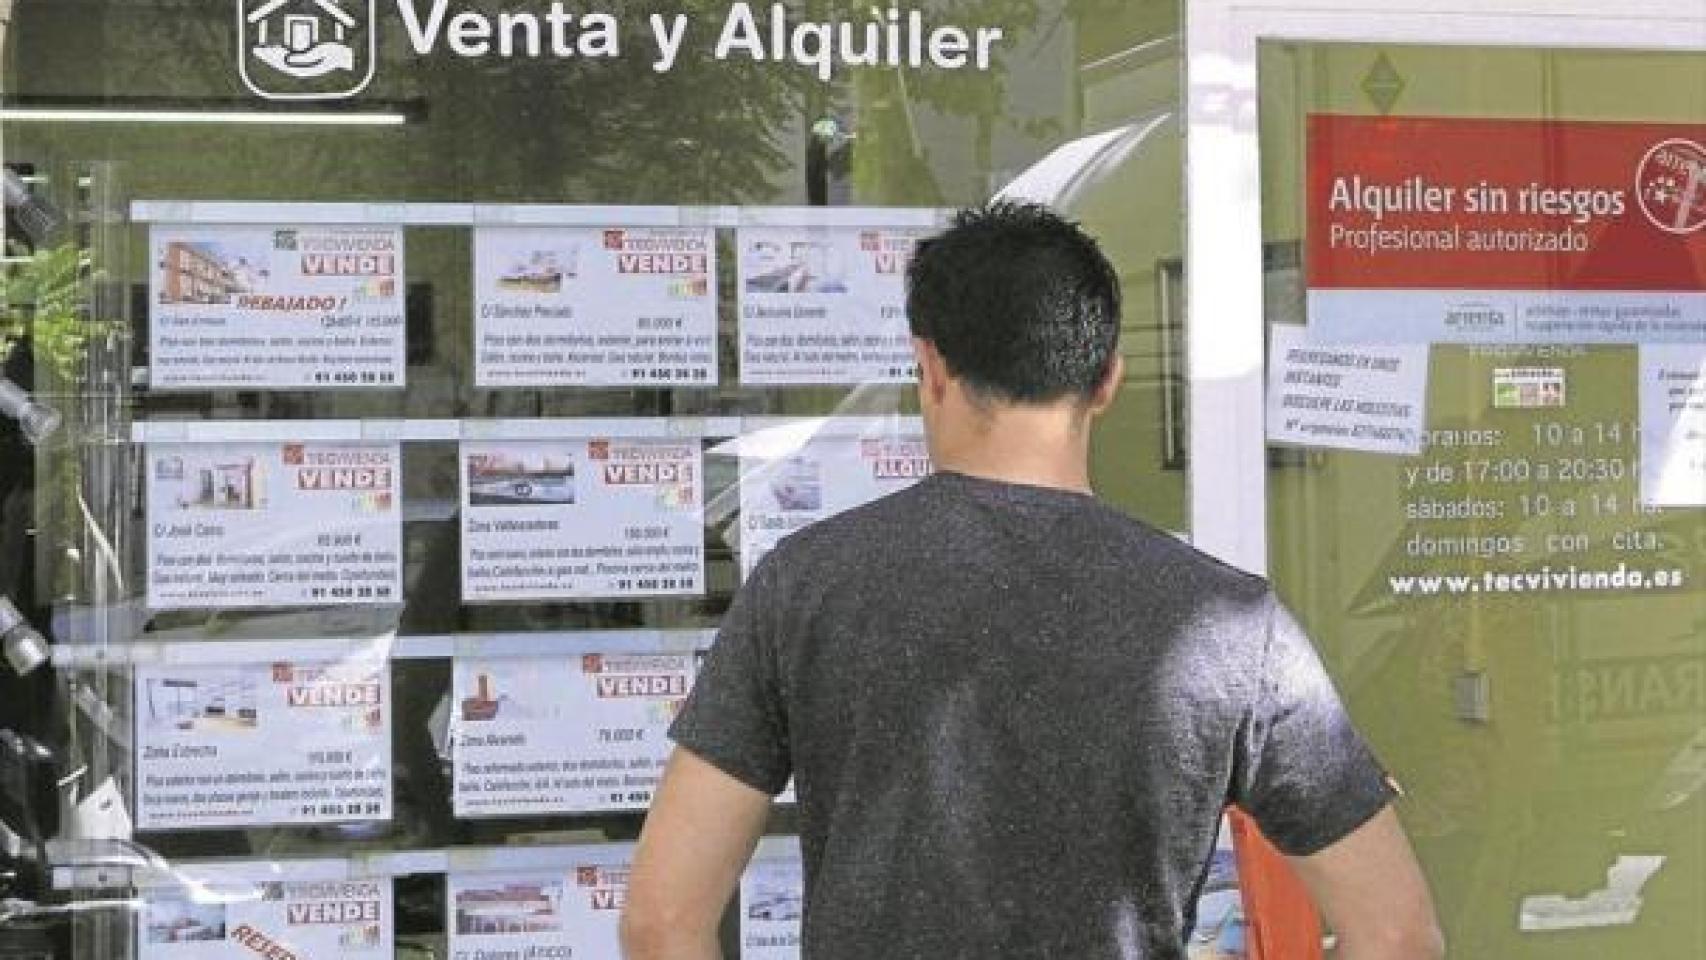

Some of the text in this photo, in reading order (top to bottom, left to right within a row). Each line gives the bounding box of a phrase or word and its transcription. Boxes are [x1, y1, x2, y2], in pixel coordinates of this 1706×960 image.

[400, 0, 1002, 80] Venta y Alquiler
[1328, 175, 1625, 224] Alquiler sin riesgos
[1329, 223, 1588, 256] Profesional autorizado
[301, 254, 394, 276] VENDE
[618, 254, 707, 273] VENDE
[1419, 427, 1504, 449] orarios:
[1534, 423, 1563, 446] 10
[1596, 422, 1621, 444] 14
[299, 467, 391, 490] VENDE
[605, 464, 693, 484] VENDE
[1405, 457, 1623, 488] y de 17:00 a 20:30
[1520, 495, 1549, 516] 10
[1593, 494, 1617, 514] 14
[1406, 531, 1664, 558] domingos con cita.
[1390, 563, 1683, 593] www.tecvivienda.es
[288, 684, 381, 707] VENDE
[597, 676, 684, 697] VENDE
[287, 902, 381, 924] VENDE
